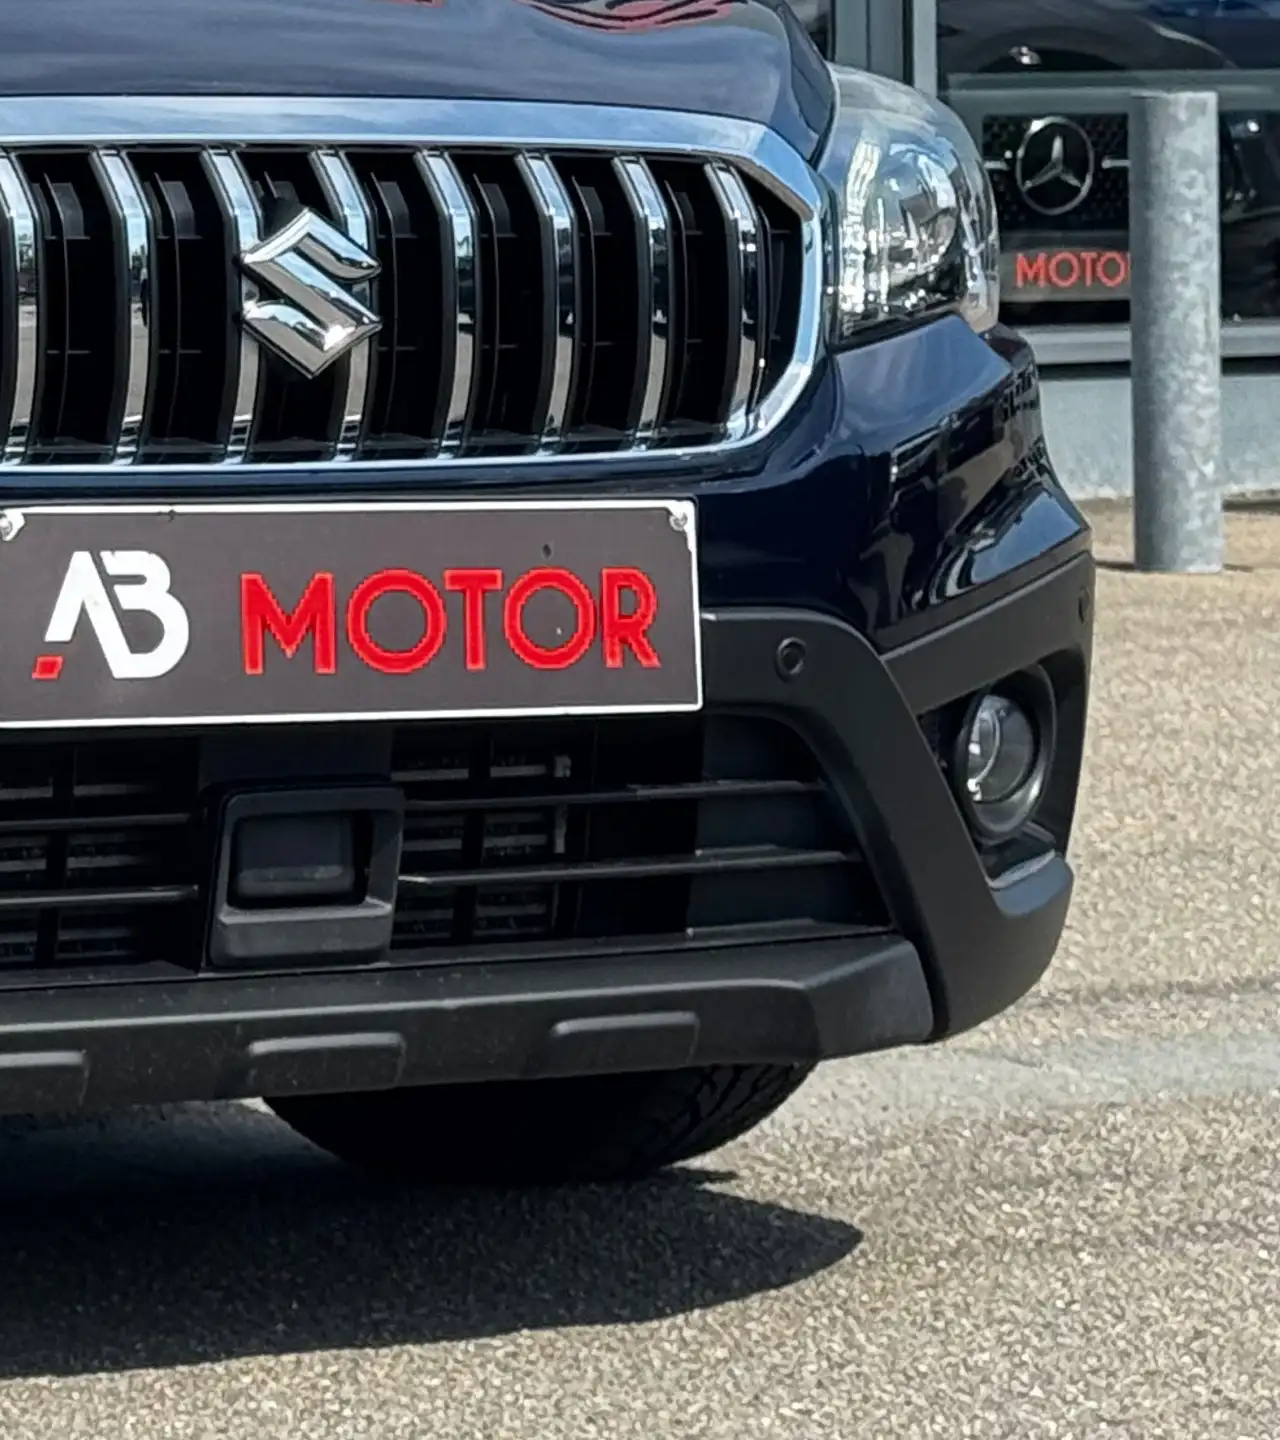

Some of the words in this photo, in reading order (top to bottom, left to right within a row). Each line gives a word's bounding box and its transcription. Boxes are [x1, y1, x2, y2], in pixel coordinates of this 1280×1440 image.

[1015, 251, 1132, 288] MOTO
[32, 550, 190, 679] AB
[240, 568, 661, 675] MOTOR
